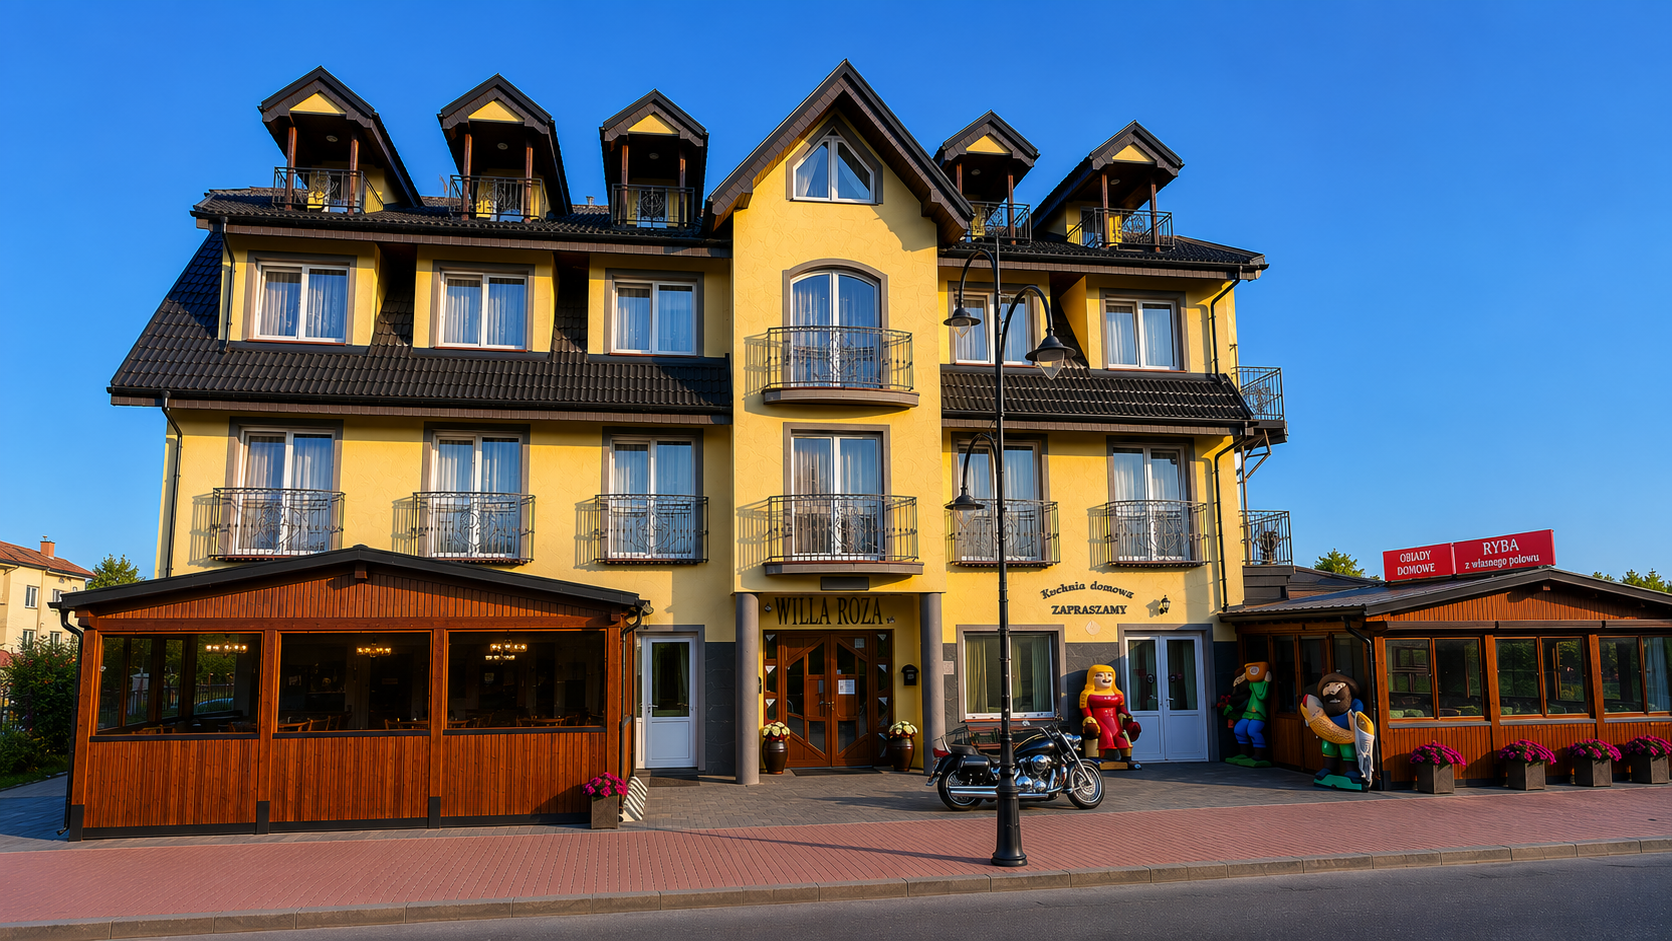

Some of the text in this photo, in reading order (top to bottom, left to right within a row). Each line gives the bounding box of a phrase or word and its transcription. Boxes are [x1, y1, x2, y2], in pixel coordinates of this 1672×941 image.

[1482, 538, 1520, 556] RYBA
[1399, 550, 1431, 563] OBIADY
[1397, 562, 1436, 576] DOMOWE
[1464, 562, 1470, 570] z
[1040, 580, 1135, 600] Kuchnia domowa
[774, 596, 884, 626] WILLA ROZA
[1050, 605, 1128, 615] ZAPRASZAMY
